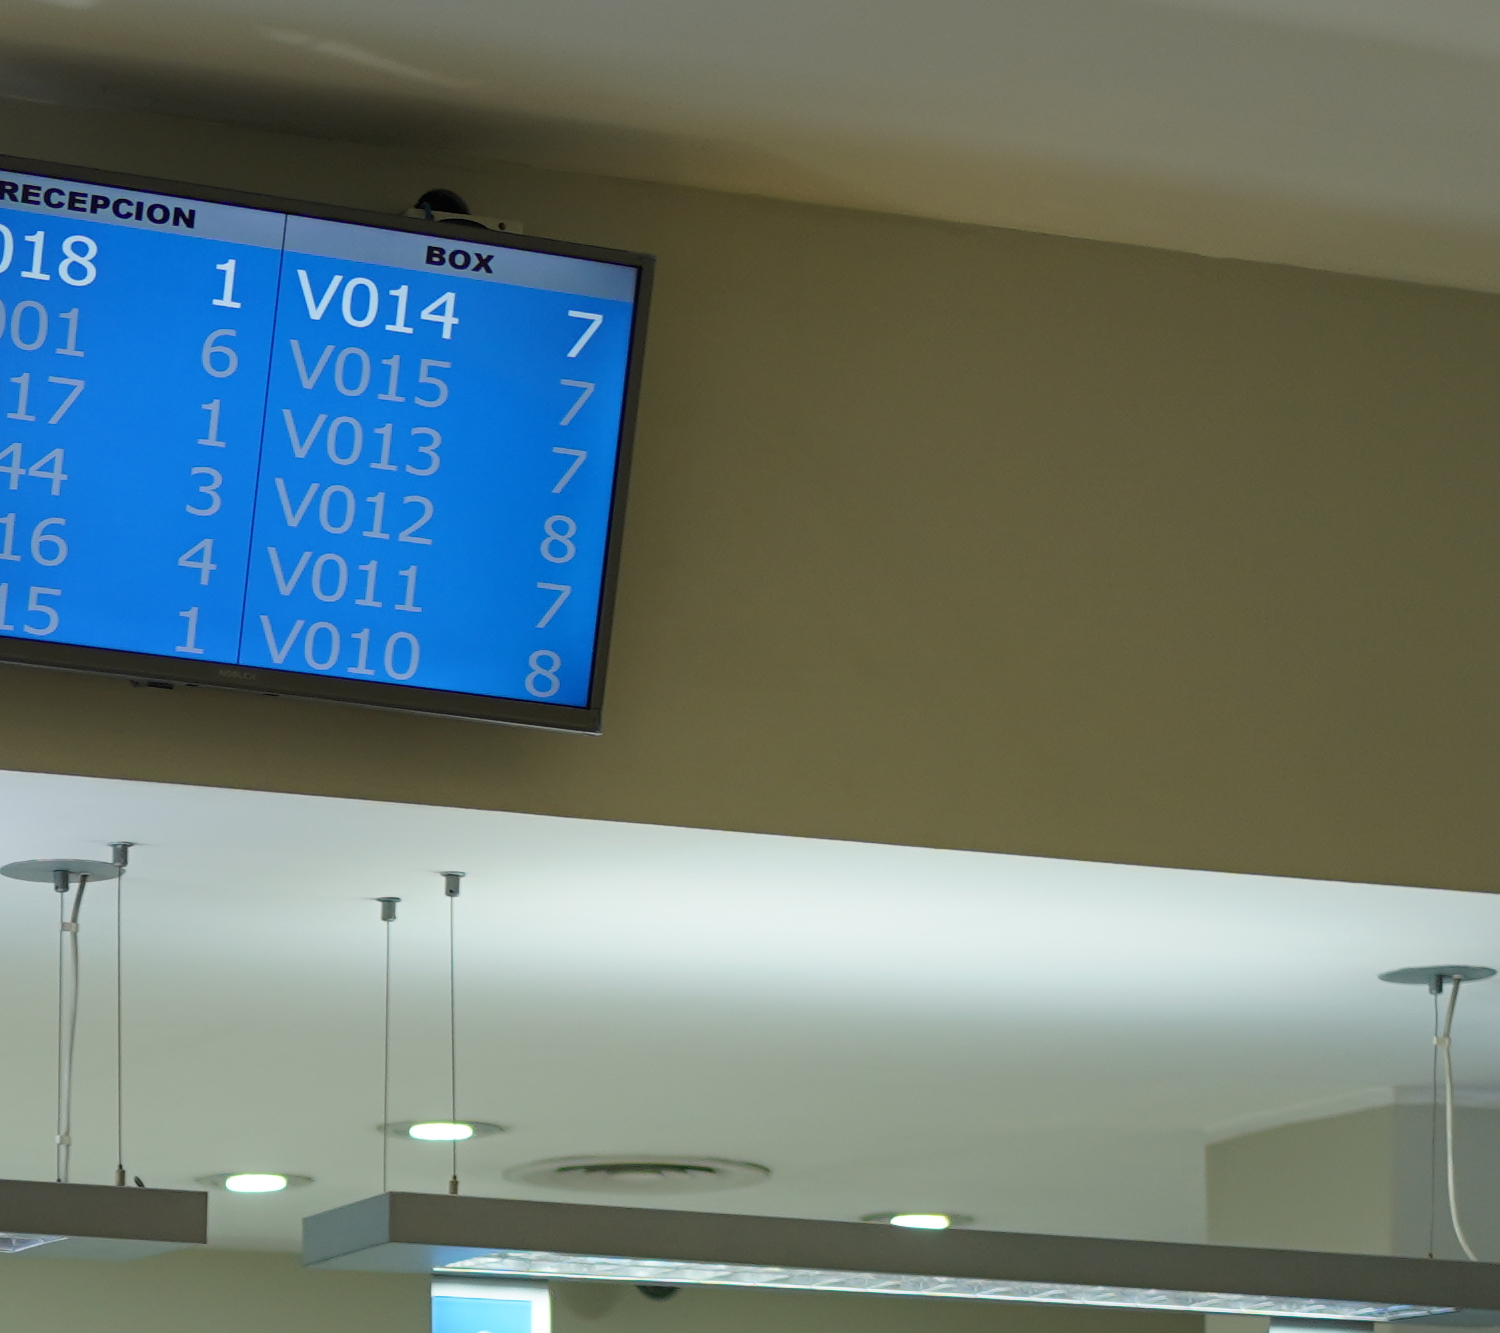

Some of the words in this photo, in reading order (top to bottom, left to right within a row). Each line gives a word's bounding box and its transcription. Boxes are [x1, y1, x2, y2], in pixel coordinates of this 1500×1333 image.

[213, 259, 241, 308] 1
[424, 245, 494, 275] BOX
[297, 269, 459, 339] V014
[568, 310, 603, 358] 7
[202, 329, 237, 378] 6
[290, 340, 450, 407] V015
[561, 380, 594, 425] 7
[198, 399, 225, 447] 1
[283, 409, 441, 476] V013
[553, 447, 586, 493] 7
[186, 467, 222, 516] 3
[275, 478, 433, 545] V012
[541, 515, 576, 563] 8
[178, 539, 216, 585] 4
[268, 547, 422, 612] V011
[537, 583, 570, 627] 7
[176, 607, 203, 654] 1
[260, 615, 419, 680] V010
[526, 650, 560, 697] 8
